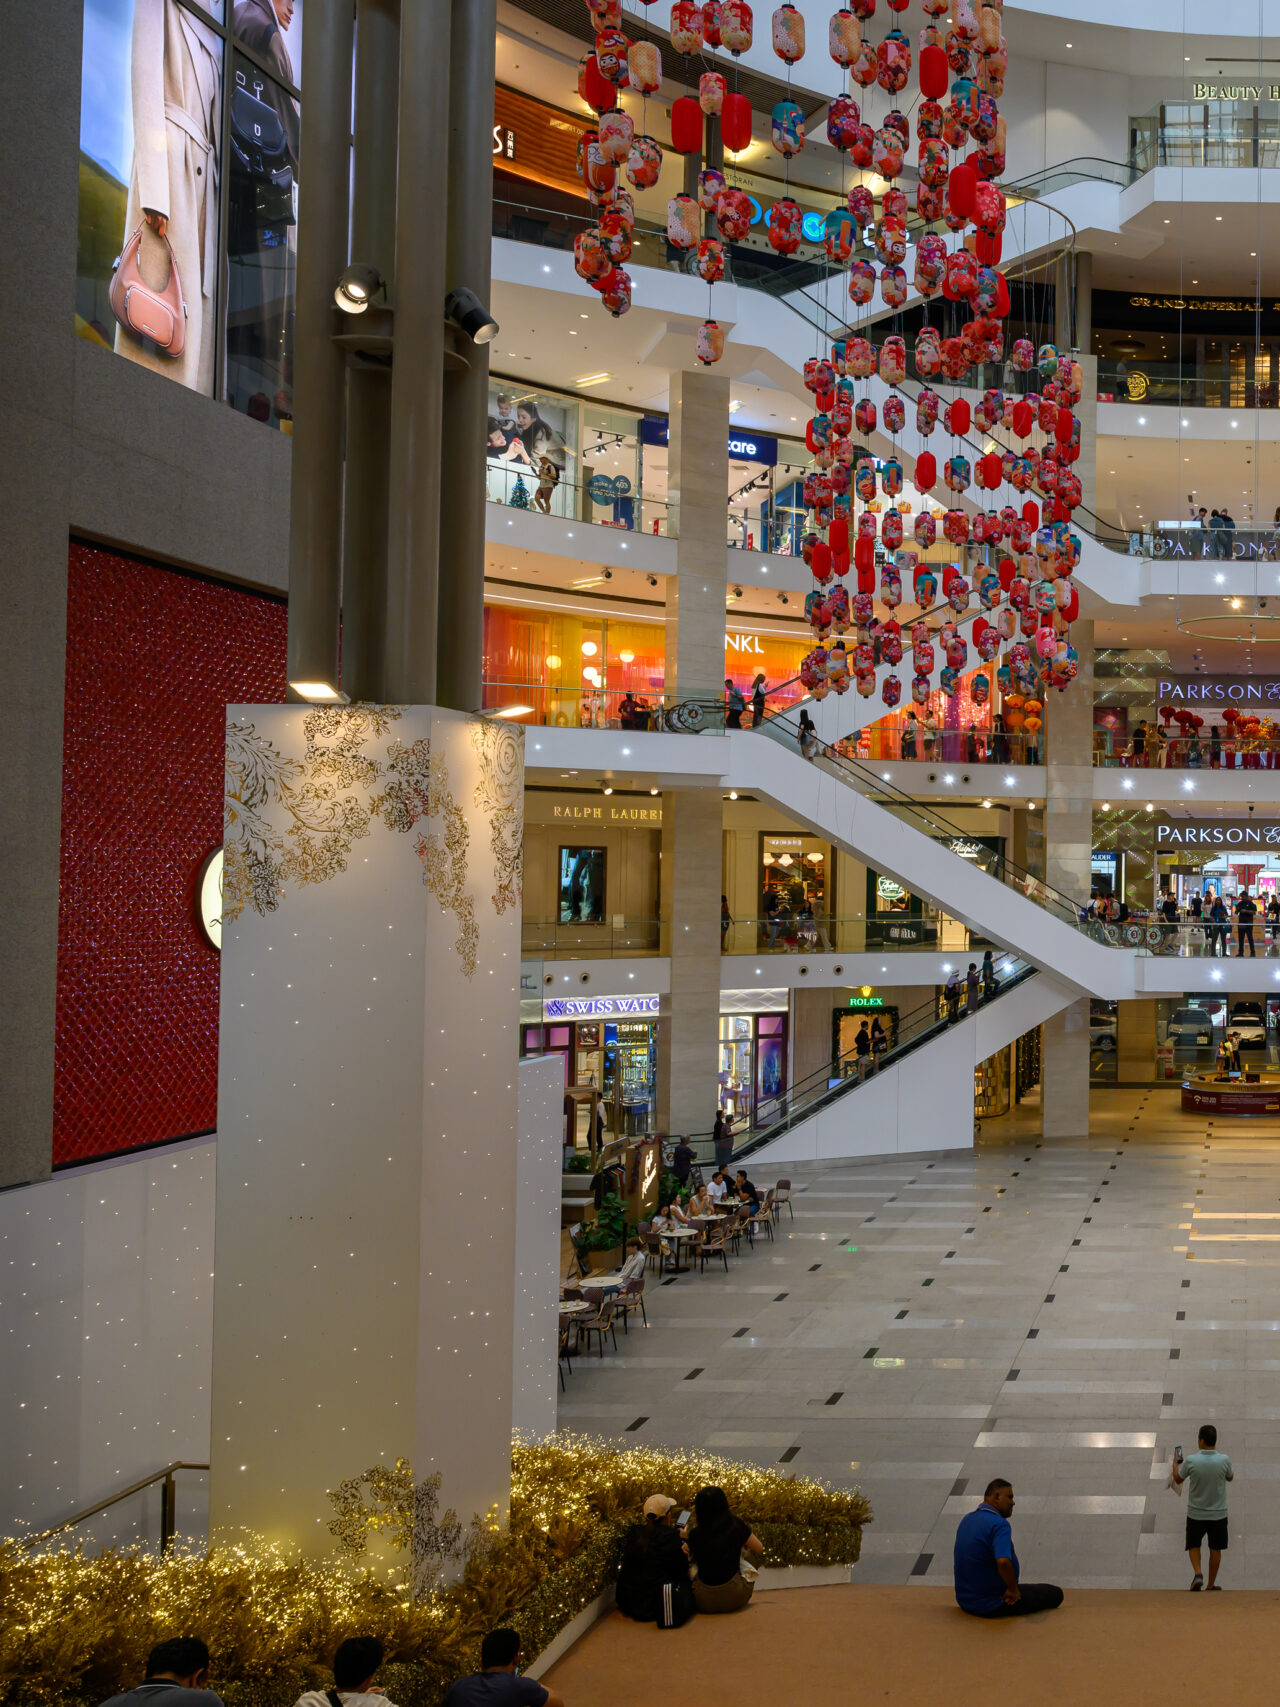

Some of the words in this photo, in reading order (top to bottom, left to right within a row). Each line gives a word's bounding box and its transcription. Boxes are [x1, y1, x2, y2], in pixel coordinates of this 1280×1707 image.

[1193, 82, 1263, 100] BEAUTY
[1130, 297, 1187, 310] GRAND
[1188, 300, 1264, 312] IMPERIAL
[1159, 682, 1262, 700] PARKSON
[553, 806, 603, 819] RALPH
[1157, 825, 1261, 844] PARKSON
[566, 1000, 613, 1015] SWISS
[849, 997, 884, 1006] ROLEX
